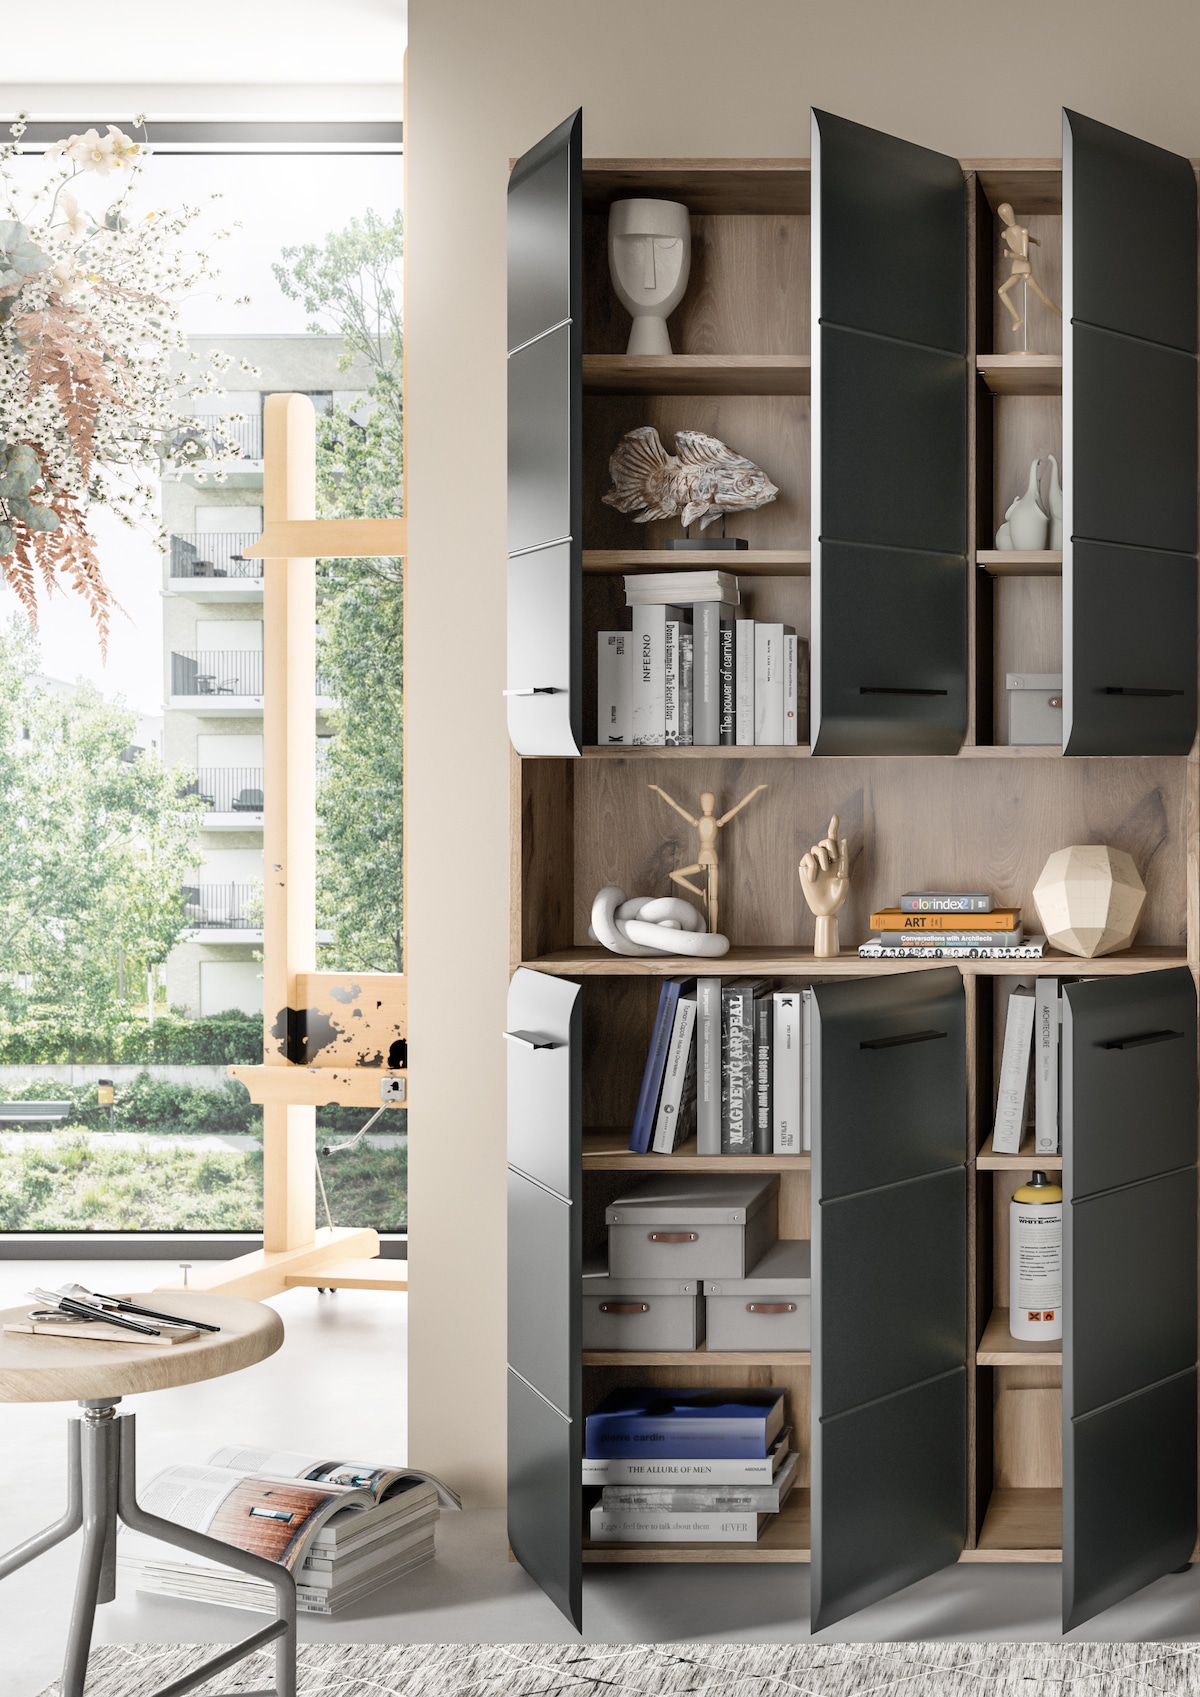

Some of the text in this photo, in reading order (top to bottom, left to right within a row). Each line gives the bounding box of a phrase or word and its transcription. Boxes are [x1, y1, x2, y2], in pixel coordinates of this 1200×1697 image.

[642, 634, 651, 683] INFERNO
[665, 624, 675, 720] Donna Summer The Secret Story
[720, 629, 736, 734] The power of carnival
[739, 695, 750, 708] get
[742, 709, 750, 718] to
[742, 719, 751, 741] know
[904, 917, 927, 928] ART
[781, 998, 793, 1008] K
[1042, 1005, 1050, 1049] ARCHITECTURE
[1008, 1022, 1027, 1075] neighbours
[757, 1045, 770, 1129] Feel secure in your house
[1001, 1088, 1020, 1104] get
[729, 1060, 744, 1145] MAGNETIC
[1004, 1106, 1020, 1117] to
[1001, 1118, 1020, 1145] know
[600, 1433, 630, 1443] pierre
[633, 1433, 665, 1442] cardin
[601, 1522, 618, 1531] Eggs
[623, 1522, 636, 1530] feel
[636, 1522, 650, 1530] free
[658, 1522, 672, 1530] talk
[672, 1522, 691, 1530] about
[692, 1522, 710, 1530] them
[720, 1523, 748, 1532] 4EVER
